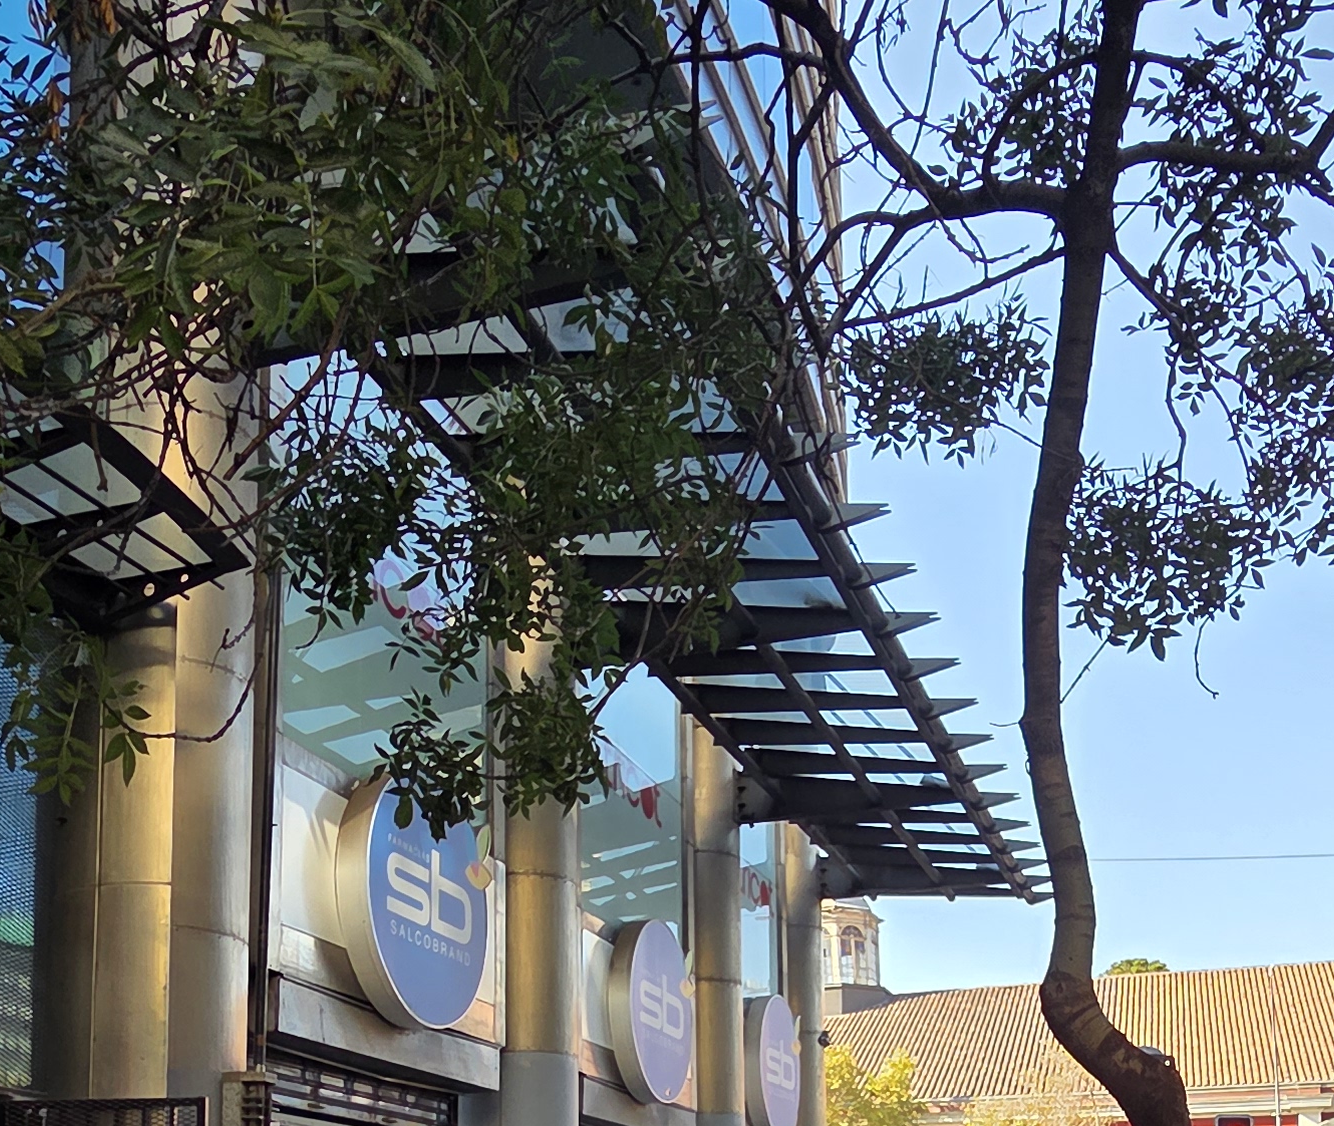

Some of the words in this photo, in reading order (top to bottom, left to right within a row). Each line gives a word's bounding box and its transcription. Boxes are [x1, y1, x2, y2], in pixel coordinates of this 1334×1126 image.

[386, 848, 473, 945] sb
[389, 919, 471, 967] SALCOBRAND
[639, 973, 685, 1040] sb
[766, 1039, 796, 1091] sb
